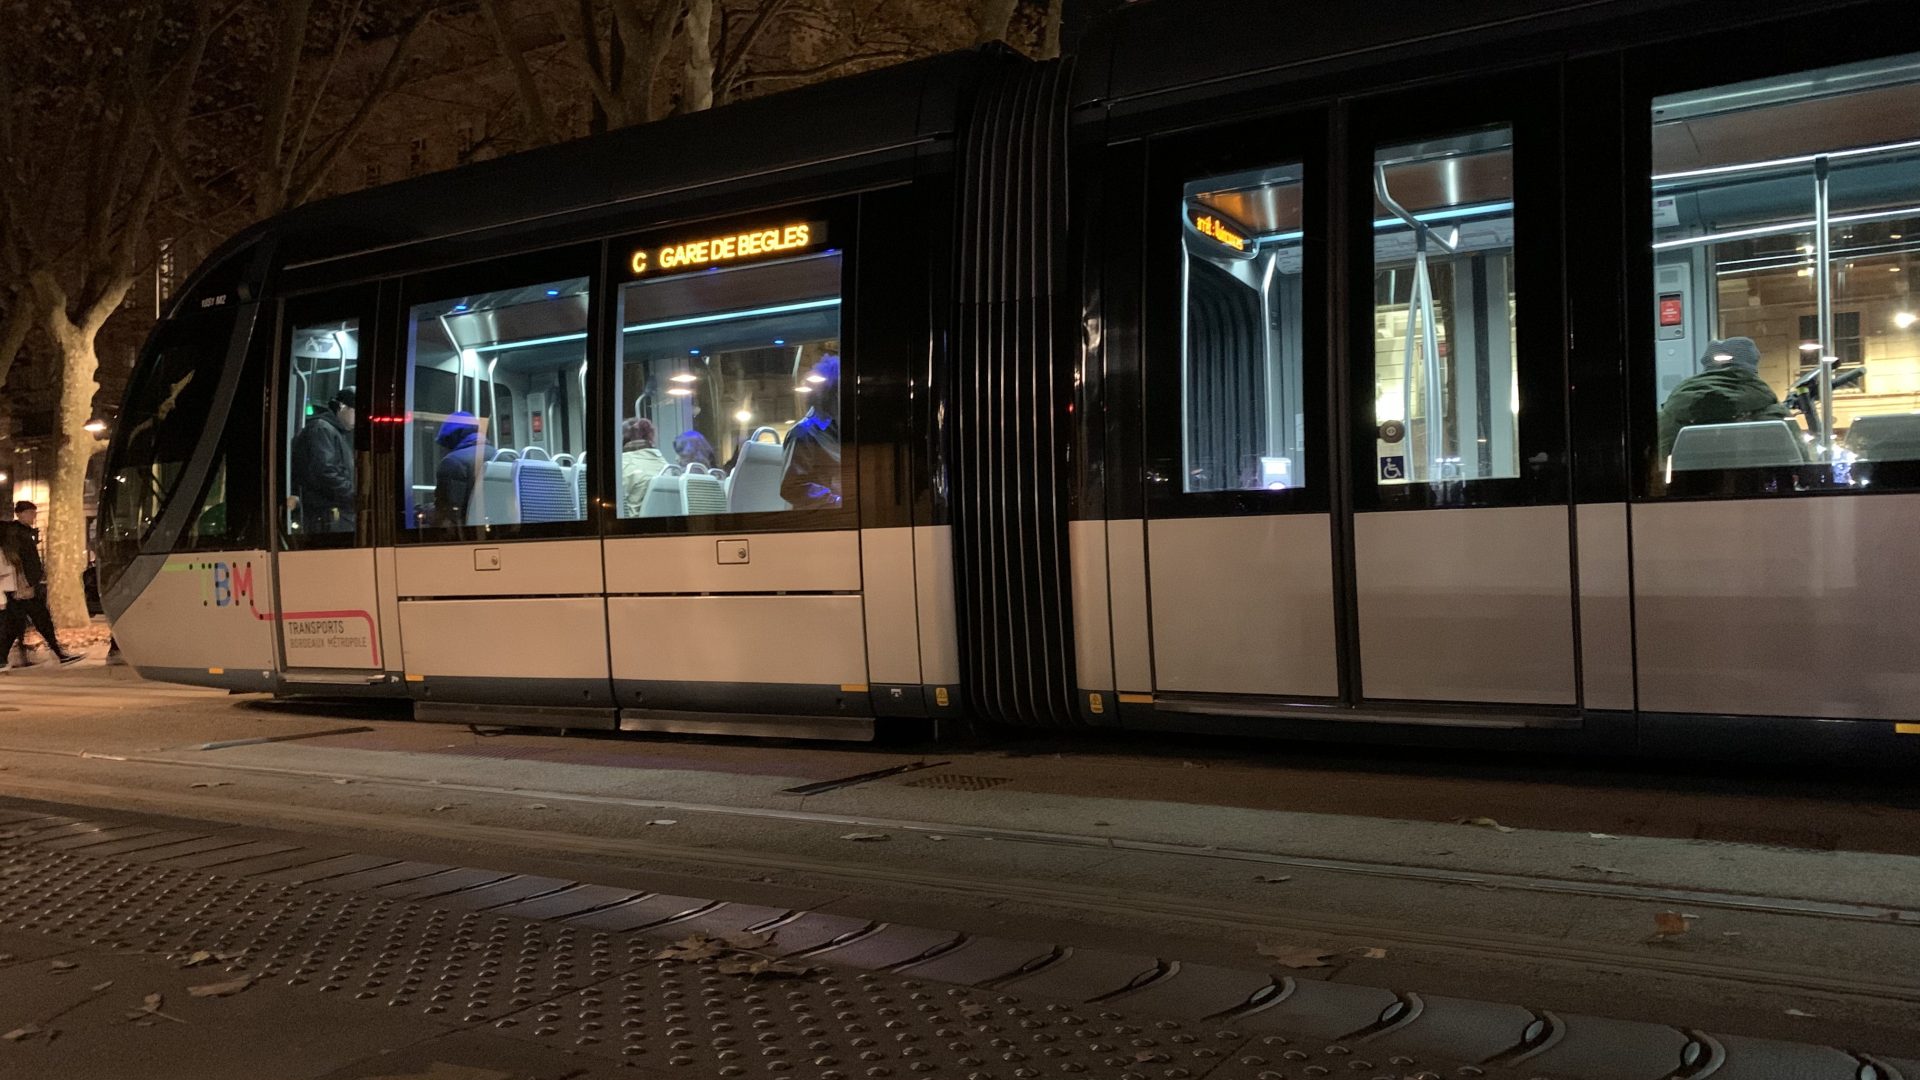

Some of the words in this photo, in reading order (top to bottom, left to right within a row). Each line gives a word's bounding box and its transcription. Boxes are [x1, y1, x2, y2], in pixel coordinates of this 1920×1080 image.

[632, 252, 647, 273] C
[659, 241, 709, 268] GARE
[711, 237, 736, 261] DE
[737, 224, 809, 257] BEGLES
[189, 561, 254, 607] TBM
[288, 620, 344, 635] TRANSPORTS
